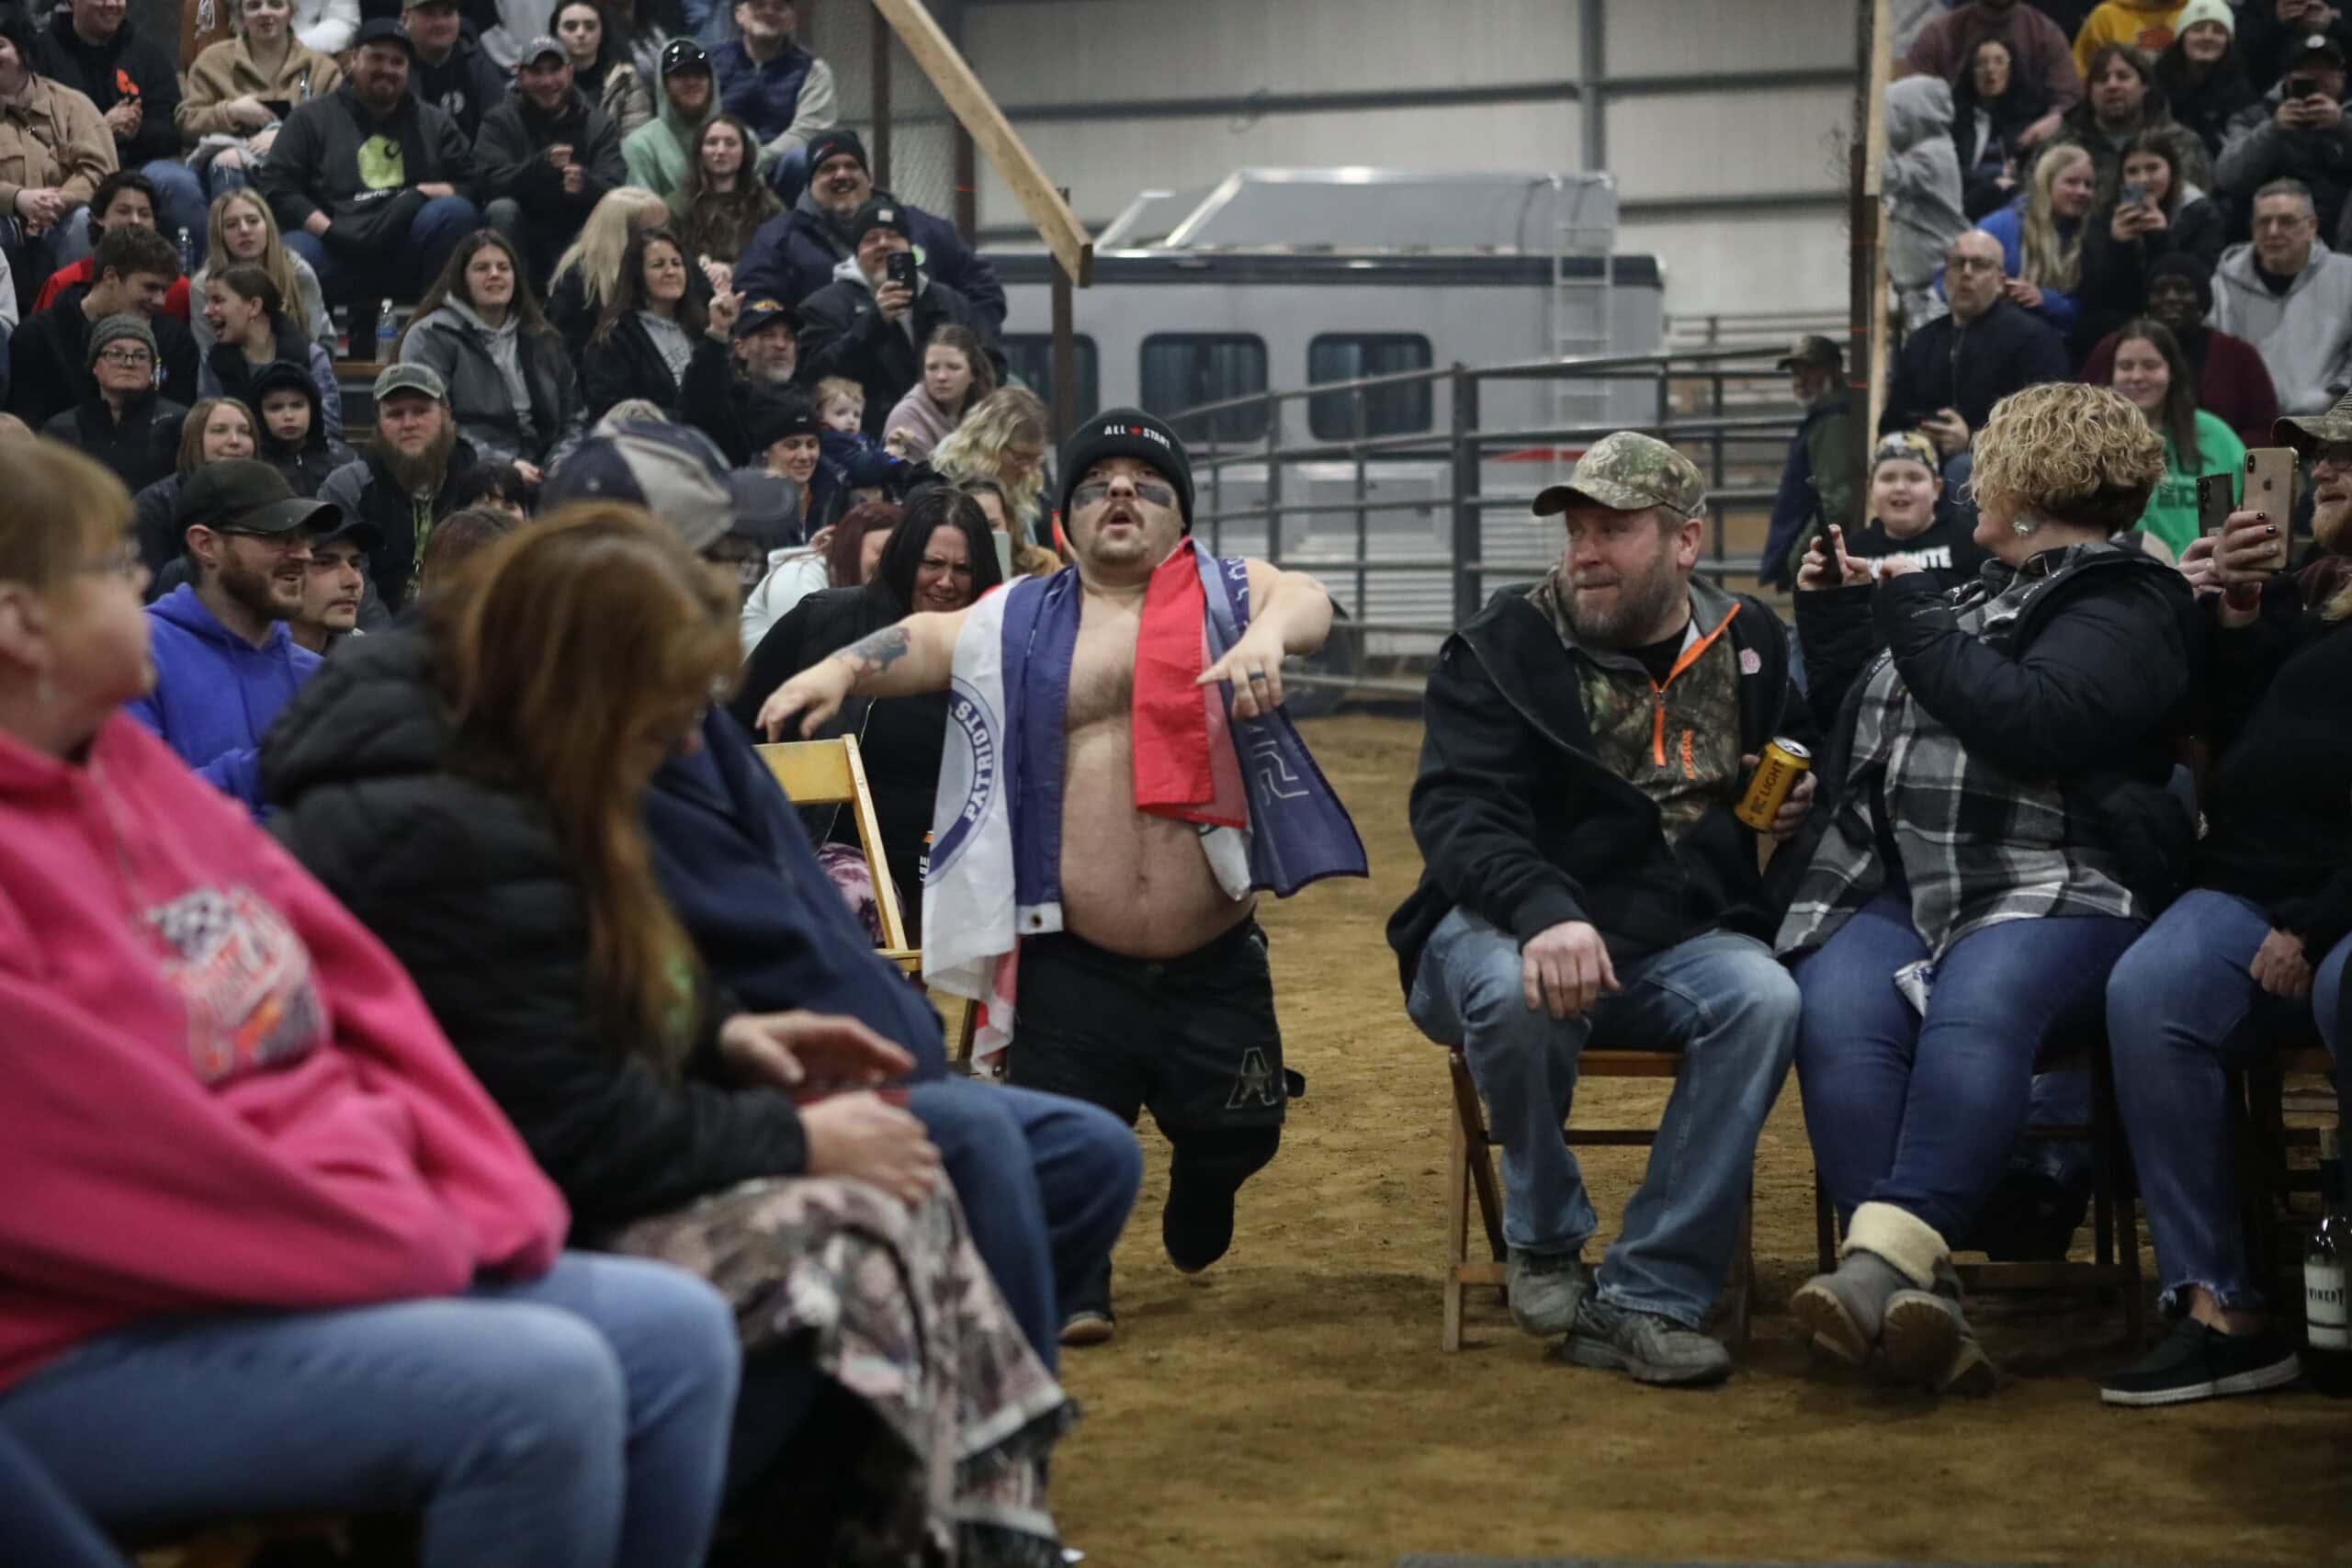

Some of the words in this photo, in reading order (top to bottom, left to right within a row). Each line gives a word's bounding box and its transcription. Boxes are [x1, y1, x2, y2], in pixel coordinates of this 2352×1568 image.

[1104, 424, 1126, 435] ALL
[955, 700, 993, 823] PATRIOTS
[1759, 759, 1785, 797] LIGHT
